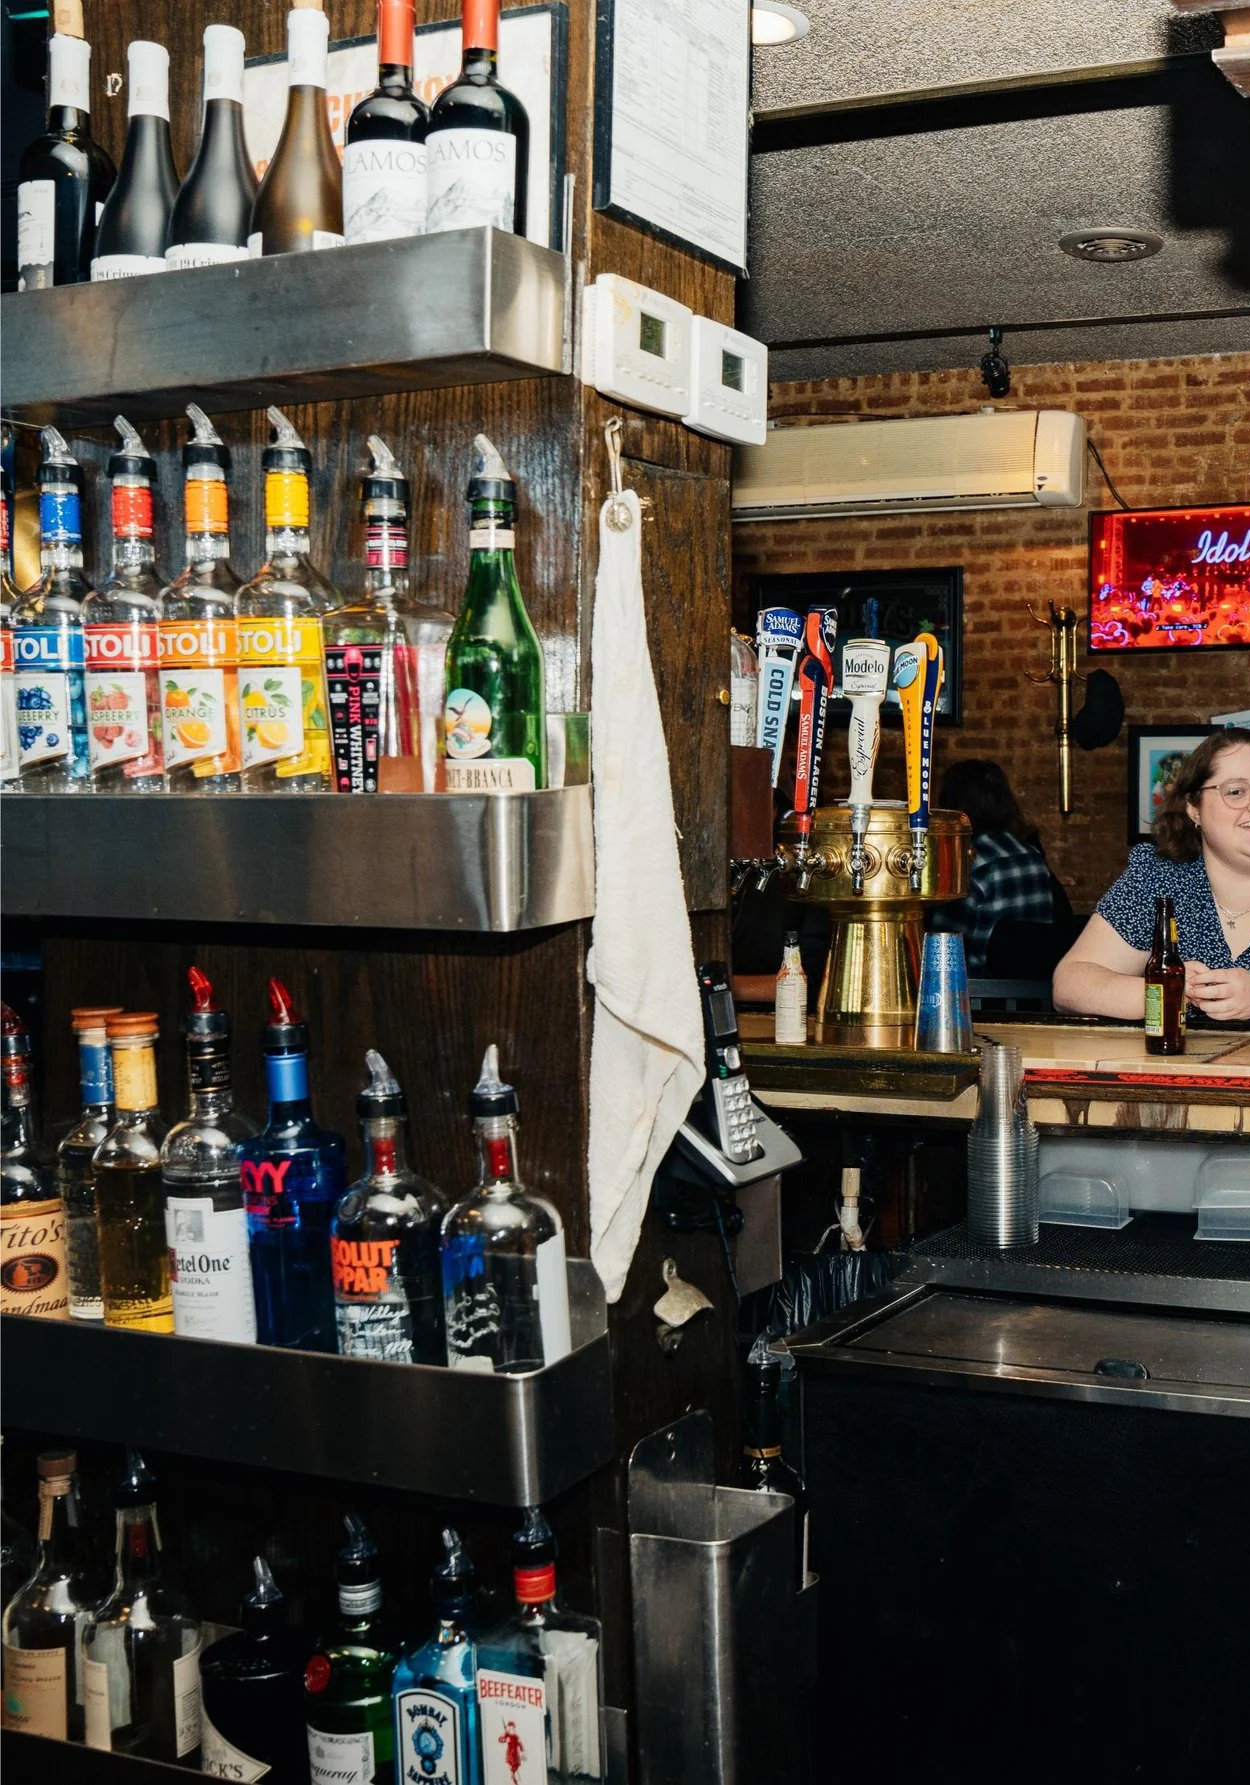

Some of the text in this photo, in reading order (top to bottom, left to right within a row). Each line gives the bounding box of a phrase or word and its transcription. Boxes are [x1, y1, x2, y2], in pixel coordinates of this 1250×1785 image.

[345, 149, 428, 175] LAMOS
[765, 613, 801, 628] SAMUEL
[767, 621, 799, 634] ADAMS
[15, 637, 68, 660] TOLI
[763, 636, 798, 645] SEASONAL
[844, 658, 885, 674] Modelo
[900, 656, 918, 669] MOON
[91, 709, 139, 722] ASPBERRY
[165, 707, 216, 720] ORANGE
[245, 706, 286, 720] CITRUS
[762, 668, 785, 752] COLD SNA
[348, 686, 364, 794] PINK WHITNEY
[797, 713, 811, 780] SAMUEL ADAMS
[808, 685, 829, 808] BOSTON LAGER
[922, 700, 932, 802] BLUE MOON
[242, 1160, 292, 1194] KYY
[199, 1253, 230, 1273] One
[330, 1239, 396, 1266] SOLUT
[179, 1277, 211, 1285] VODKA
[332, 1267, 390, 1293] PPAR
[479, 1678, 544, 1710] BEEFEATER
[406, 1703, 449, 1728] BOMBAY
[205, 1760, 244, 1779] ICK'S
[312, 1763, 359, 1785] queray
